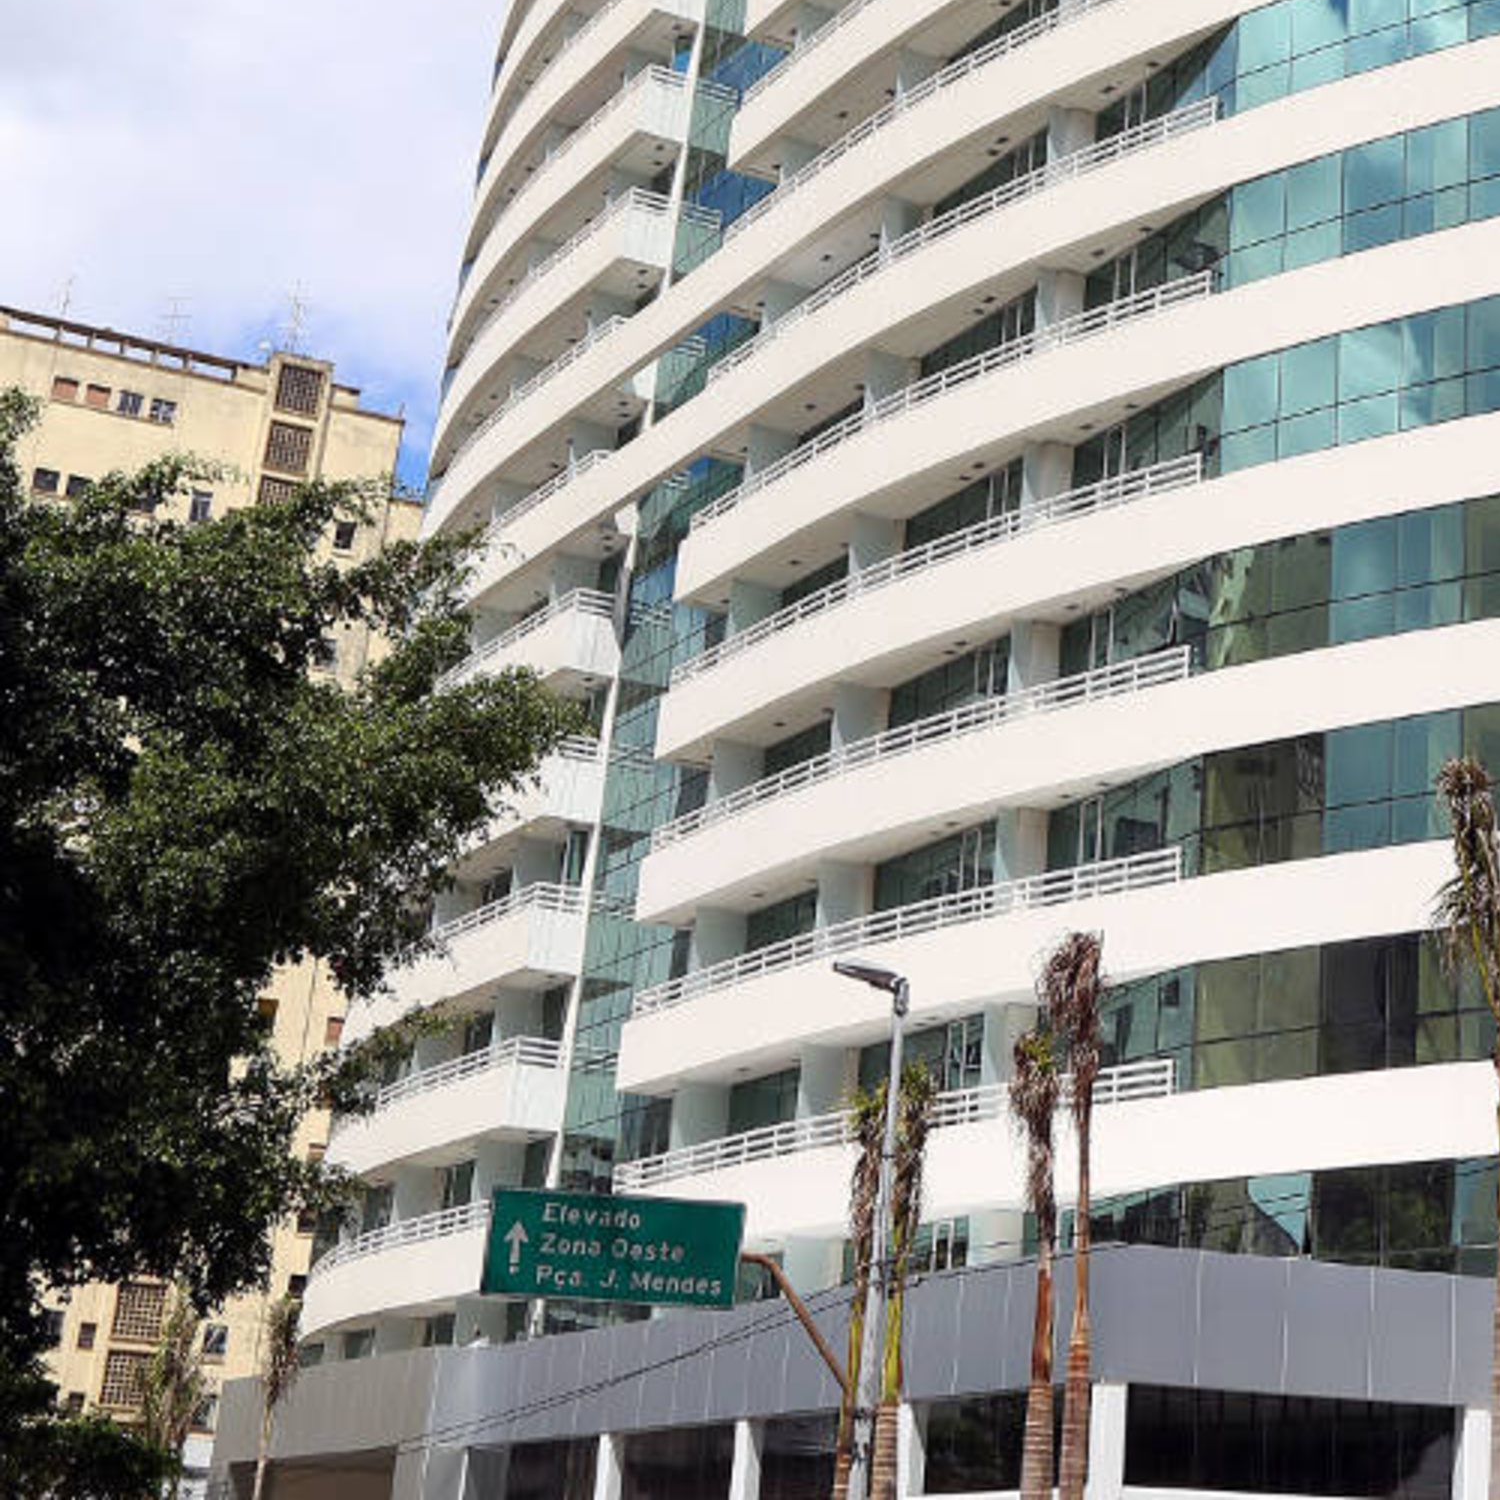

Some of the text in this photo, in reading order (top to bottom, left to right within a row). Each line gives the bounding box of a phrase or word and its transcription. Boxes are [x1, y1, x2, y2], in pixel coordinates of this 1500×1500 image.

[542, 1201, 641, 1229] Elevado
[539, 1233, 685, 1263] Zona Oeste
[599, 1270, 619, 1289] J.
[630, 1272, 722, 1297] Mendes
